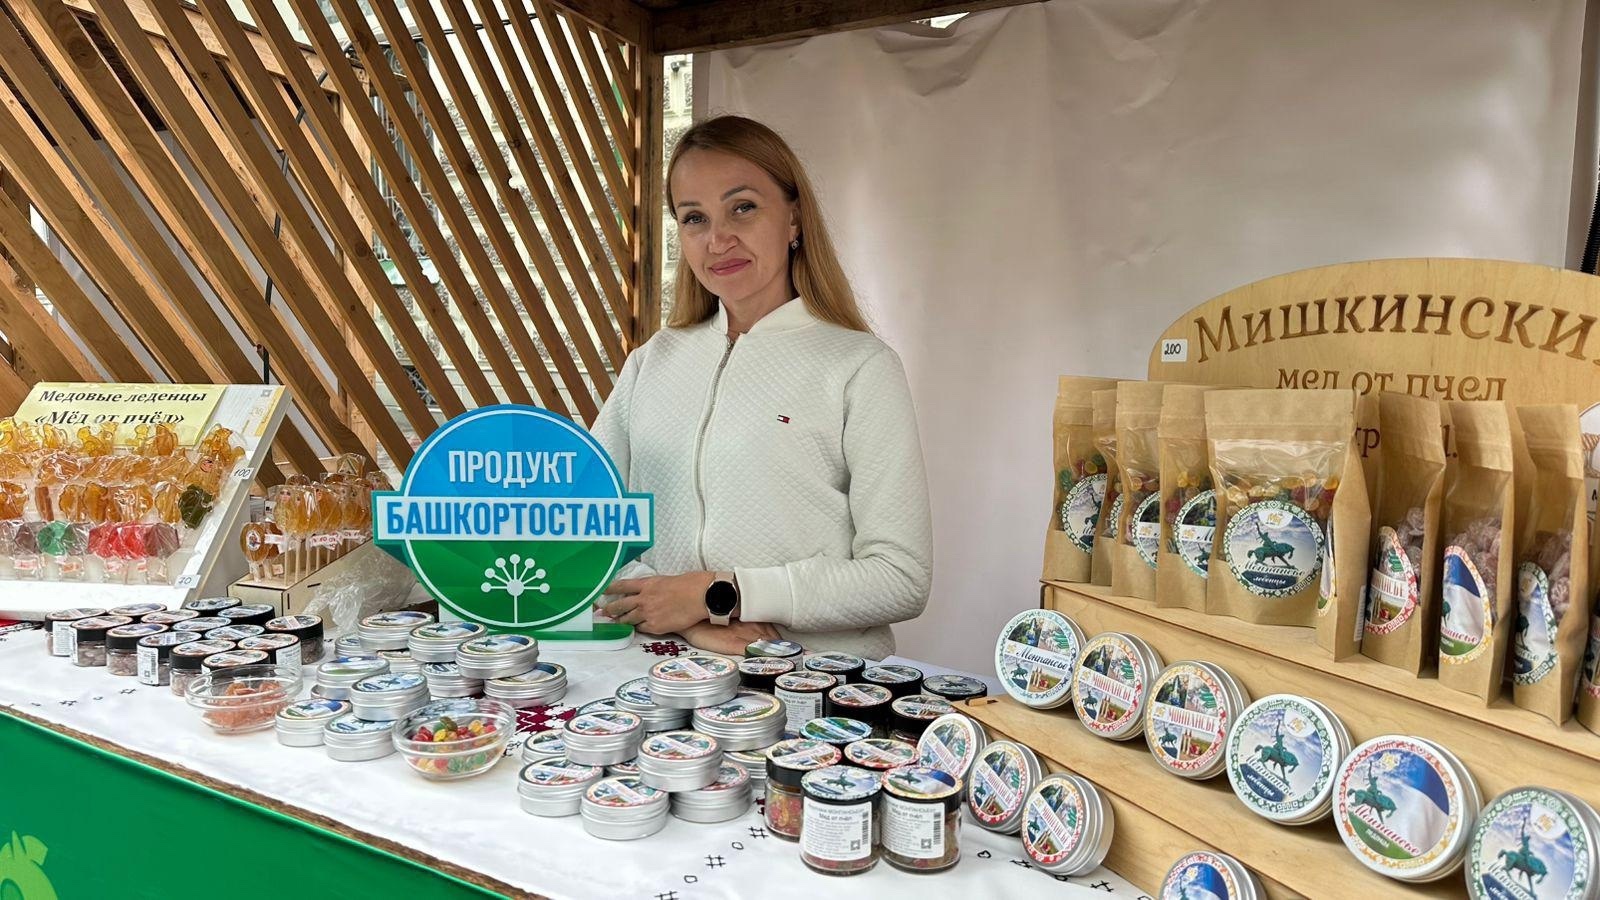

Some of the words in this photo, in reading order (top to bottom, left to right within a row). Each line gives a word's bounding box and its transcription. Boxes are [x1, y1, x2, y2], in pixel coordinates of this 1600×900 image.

[1193, 293, 1600, 365] Мишкински
[1164, 342, 1181, 355] 200
[38, 390, 122, 402] Медовые
[124, 391, 207, 402] леденцы
[1351, 371, 1394, 396] от
[1406, 373, 1508, 402] пчел
[34, 411, 88, 425] «Мёд
[94, 412, 118, 423] от
[123, 411, 186, 425] пчёл»
[234, 468, 251, 478] 100
[449, 450, 577, 488] ПРОДУКТ
[386, 502, 642, 536] БАШКОРТОСТАНА
